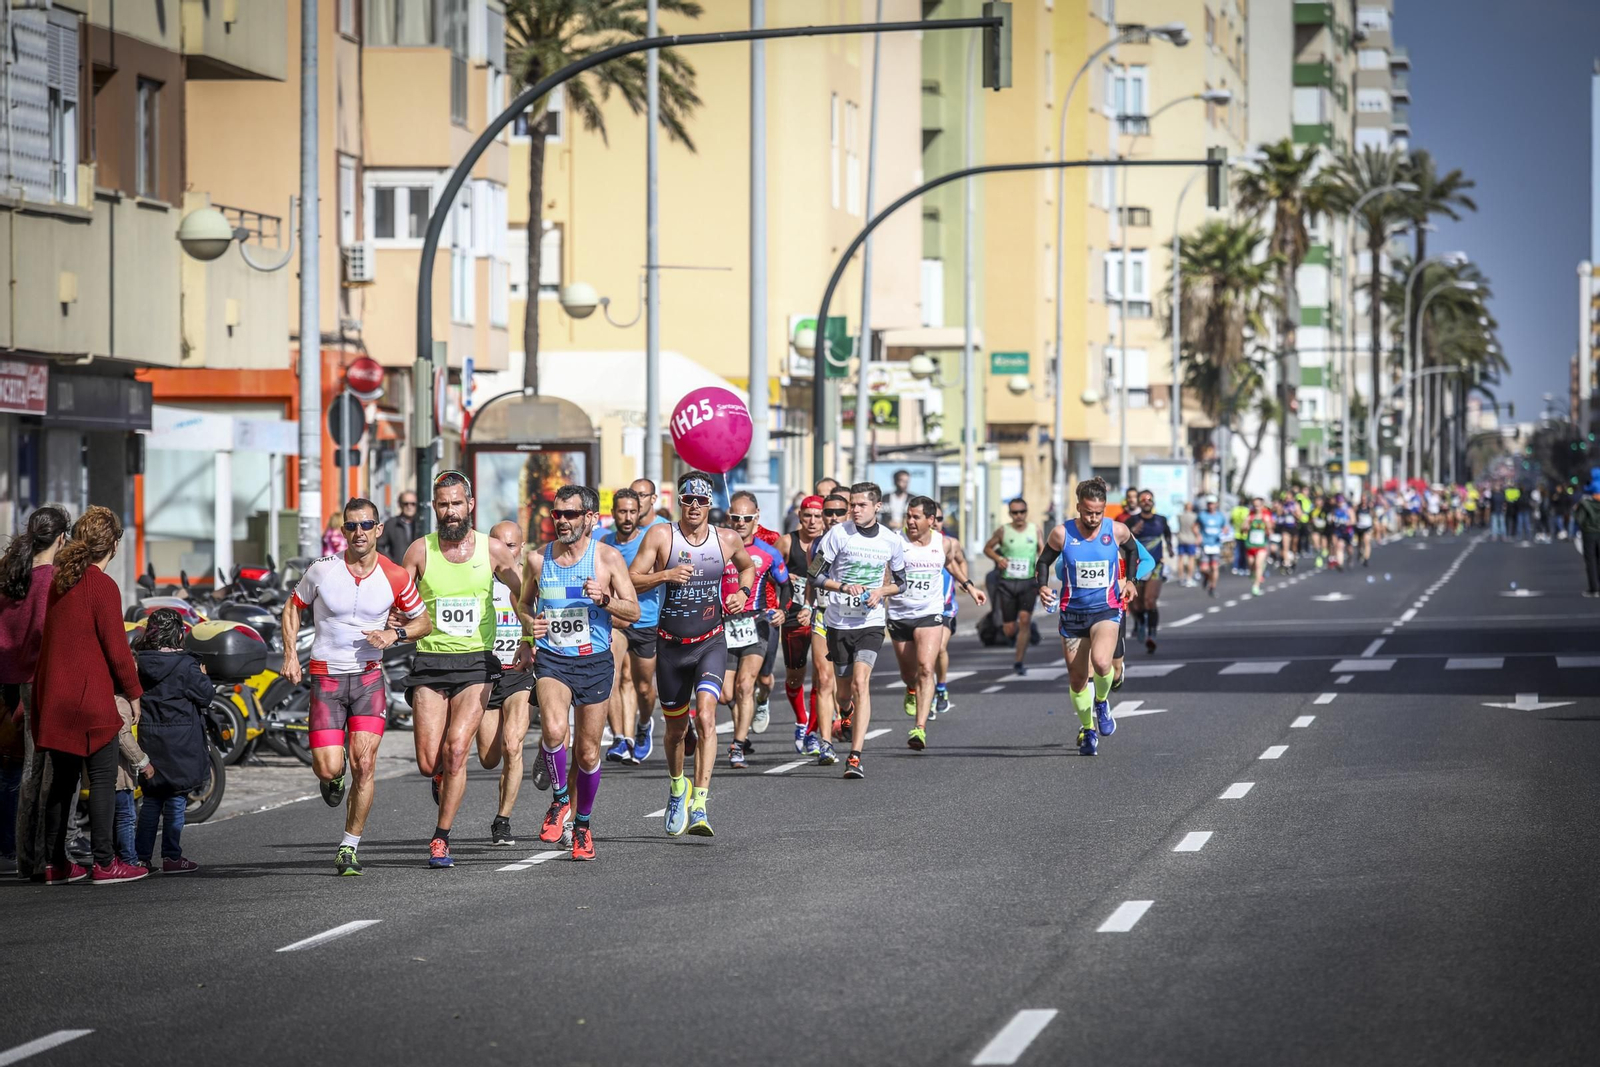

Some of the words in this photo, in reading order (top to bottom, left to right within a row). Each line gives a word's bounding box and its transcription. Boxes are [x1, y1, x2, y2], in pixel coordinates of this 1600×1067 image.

[1080, 569, 1105, 579] 294
[441, 609, 474, 623] 901
[550, 619, 584, 634] 896
